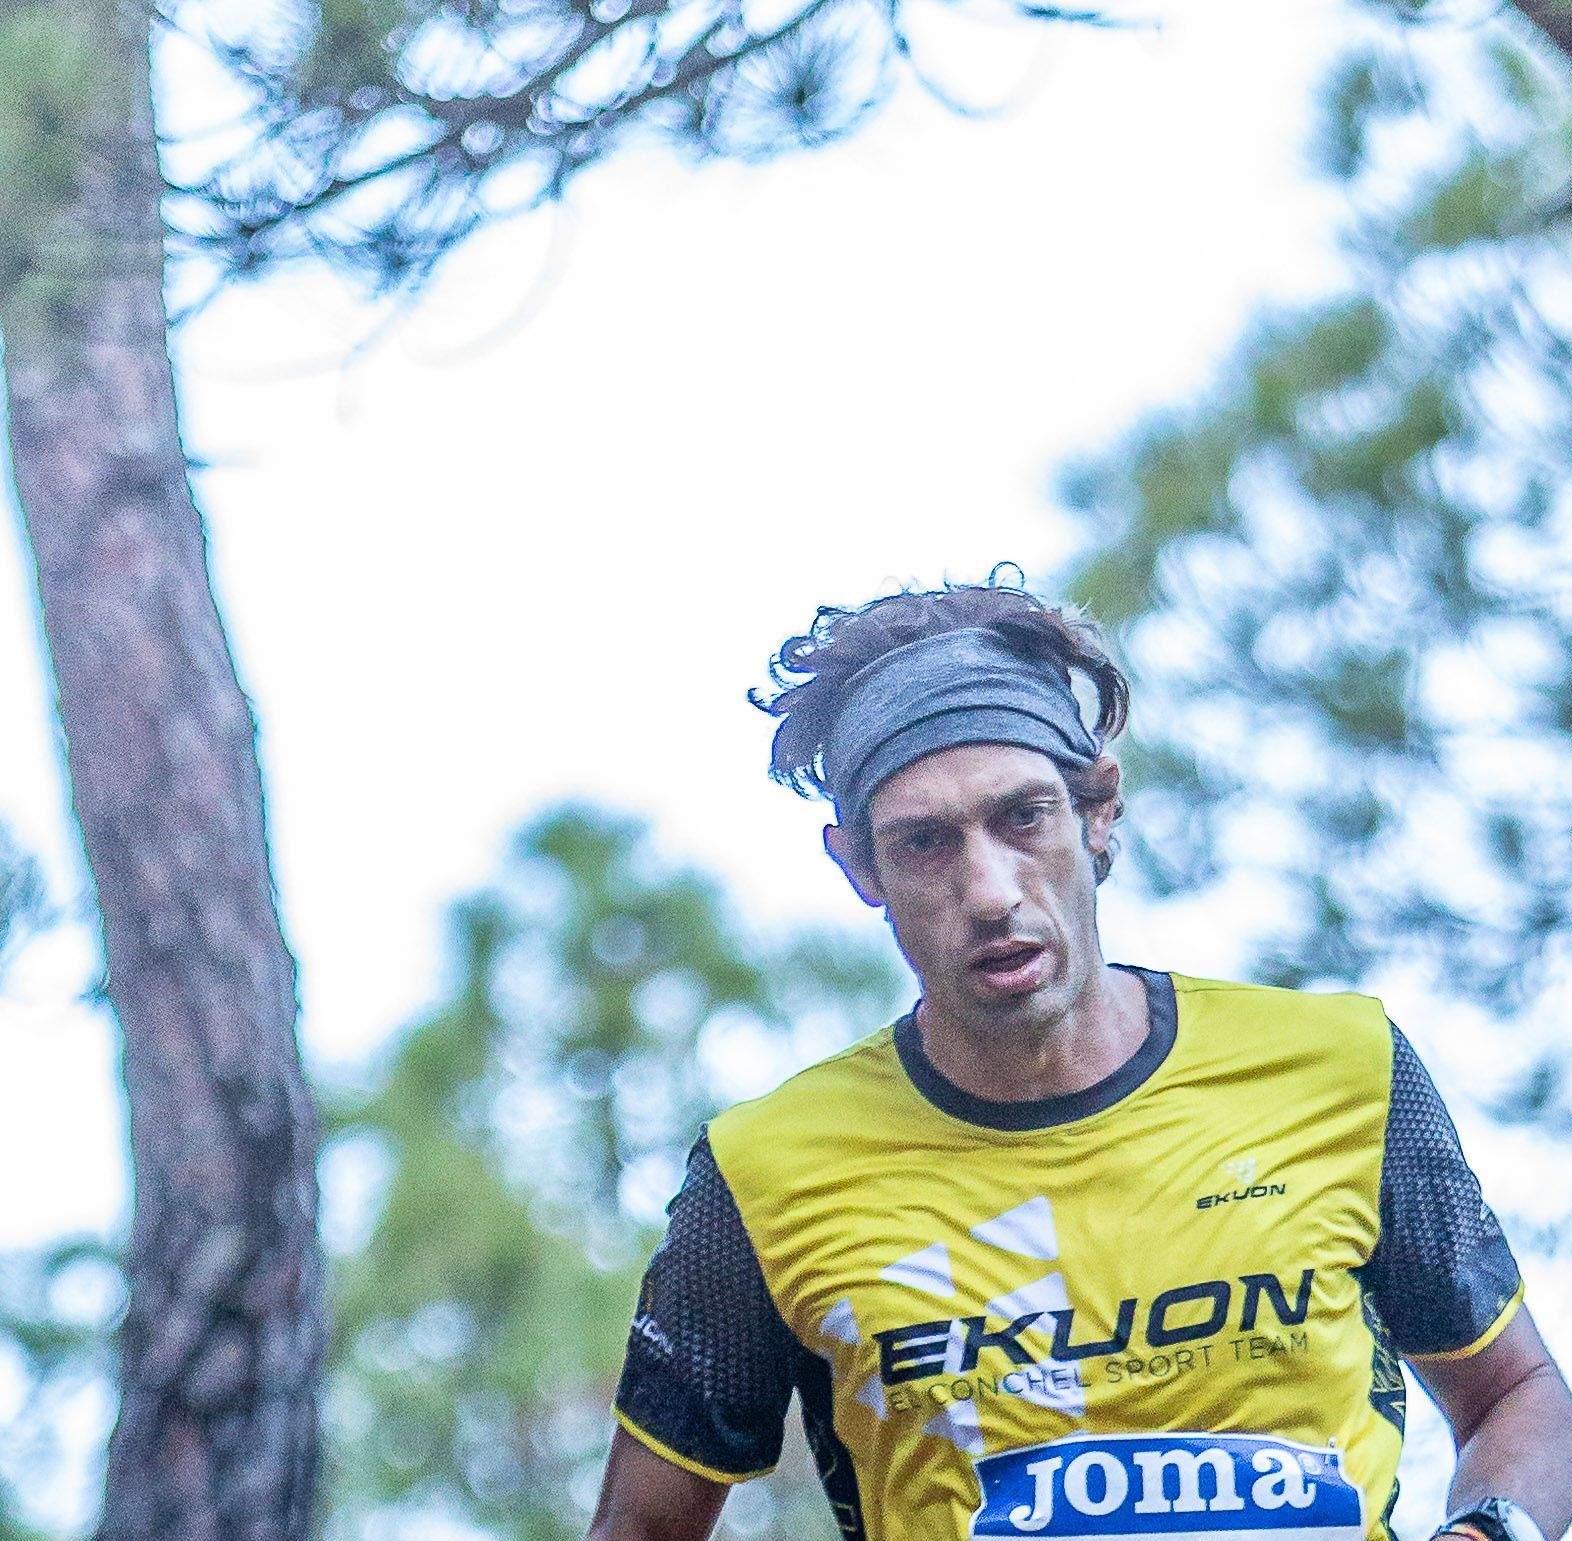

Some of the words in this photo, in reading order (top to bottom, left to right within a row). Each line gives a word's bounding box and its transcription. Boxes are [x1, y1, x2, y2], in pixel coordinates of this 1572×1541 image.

[1195, 1183, 1286, 1210] EKUON
[871, 1268, 1316, 1386] EKUON
[928, 1365, 1093, 1404] CONCHEL
[1105, 1344, 1214, 1384] SPORT
[1229, 1331, 1308, 1362] TEAM
